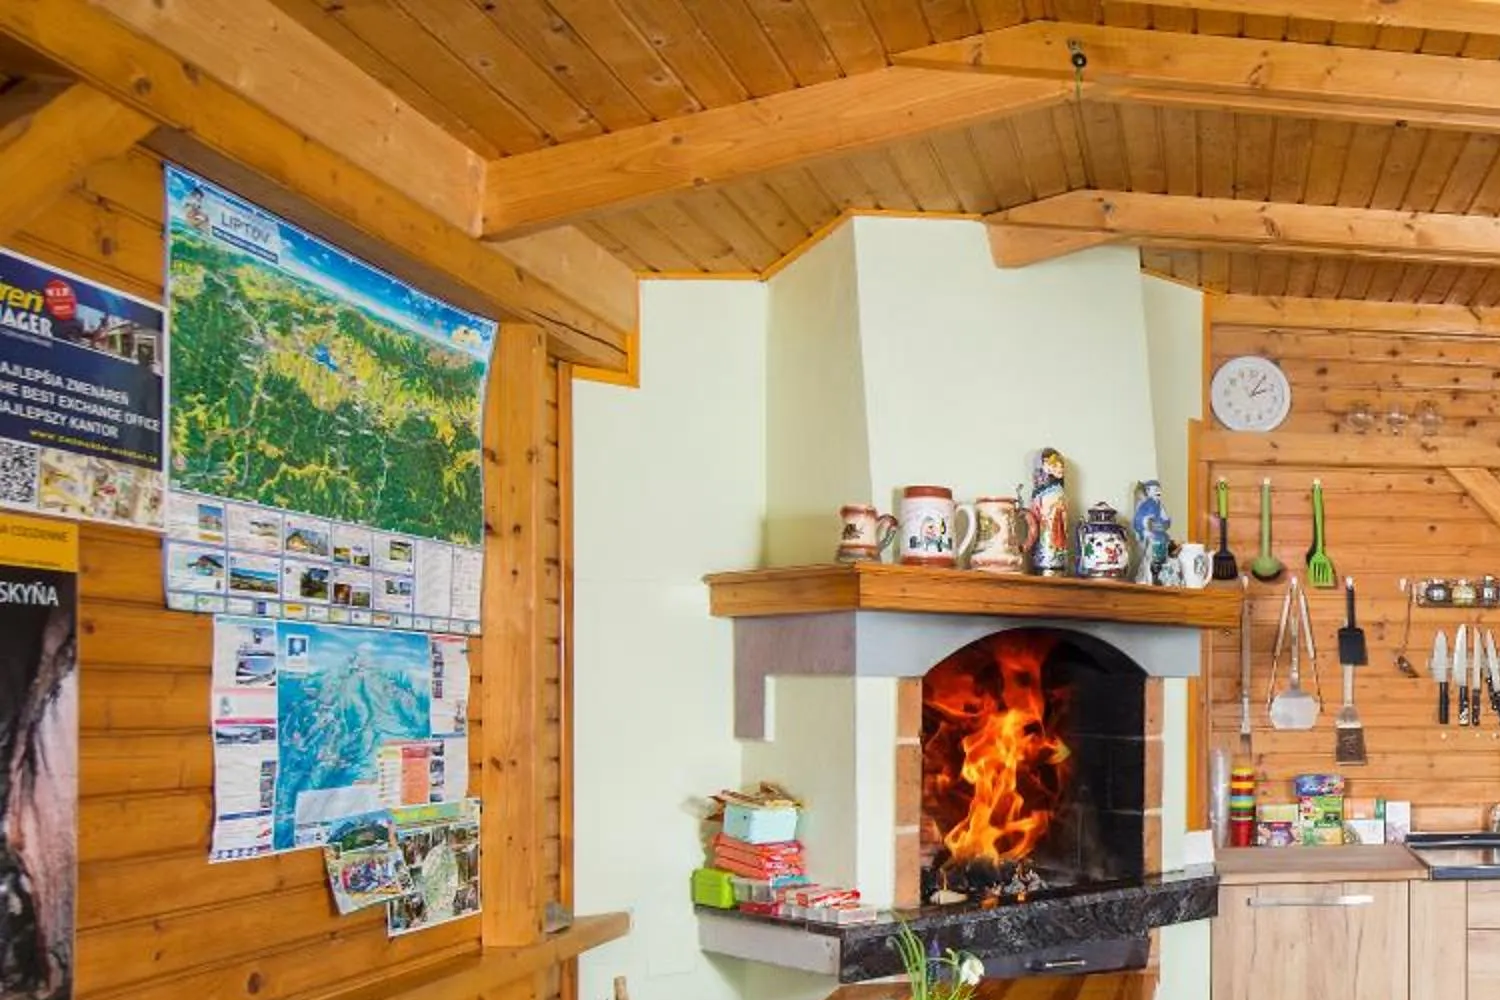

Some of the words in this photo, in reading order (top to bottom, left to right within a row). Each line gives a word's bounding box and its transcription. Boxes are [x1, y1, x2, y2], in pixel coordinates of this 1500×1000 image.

[220, 211, 271, 244] LIPTOV
[0, 304, 53, 337] AGER
[21, 385, 55, 405] BEST
[58, 395, 123, 423] EXCHANGE
[124, 412, 160, 432] OFFICE
[69, 416, 119, 439] KANTOR
